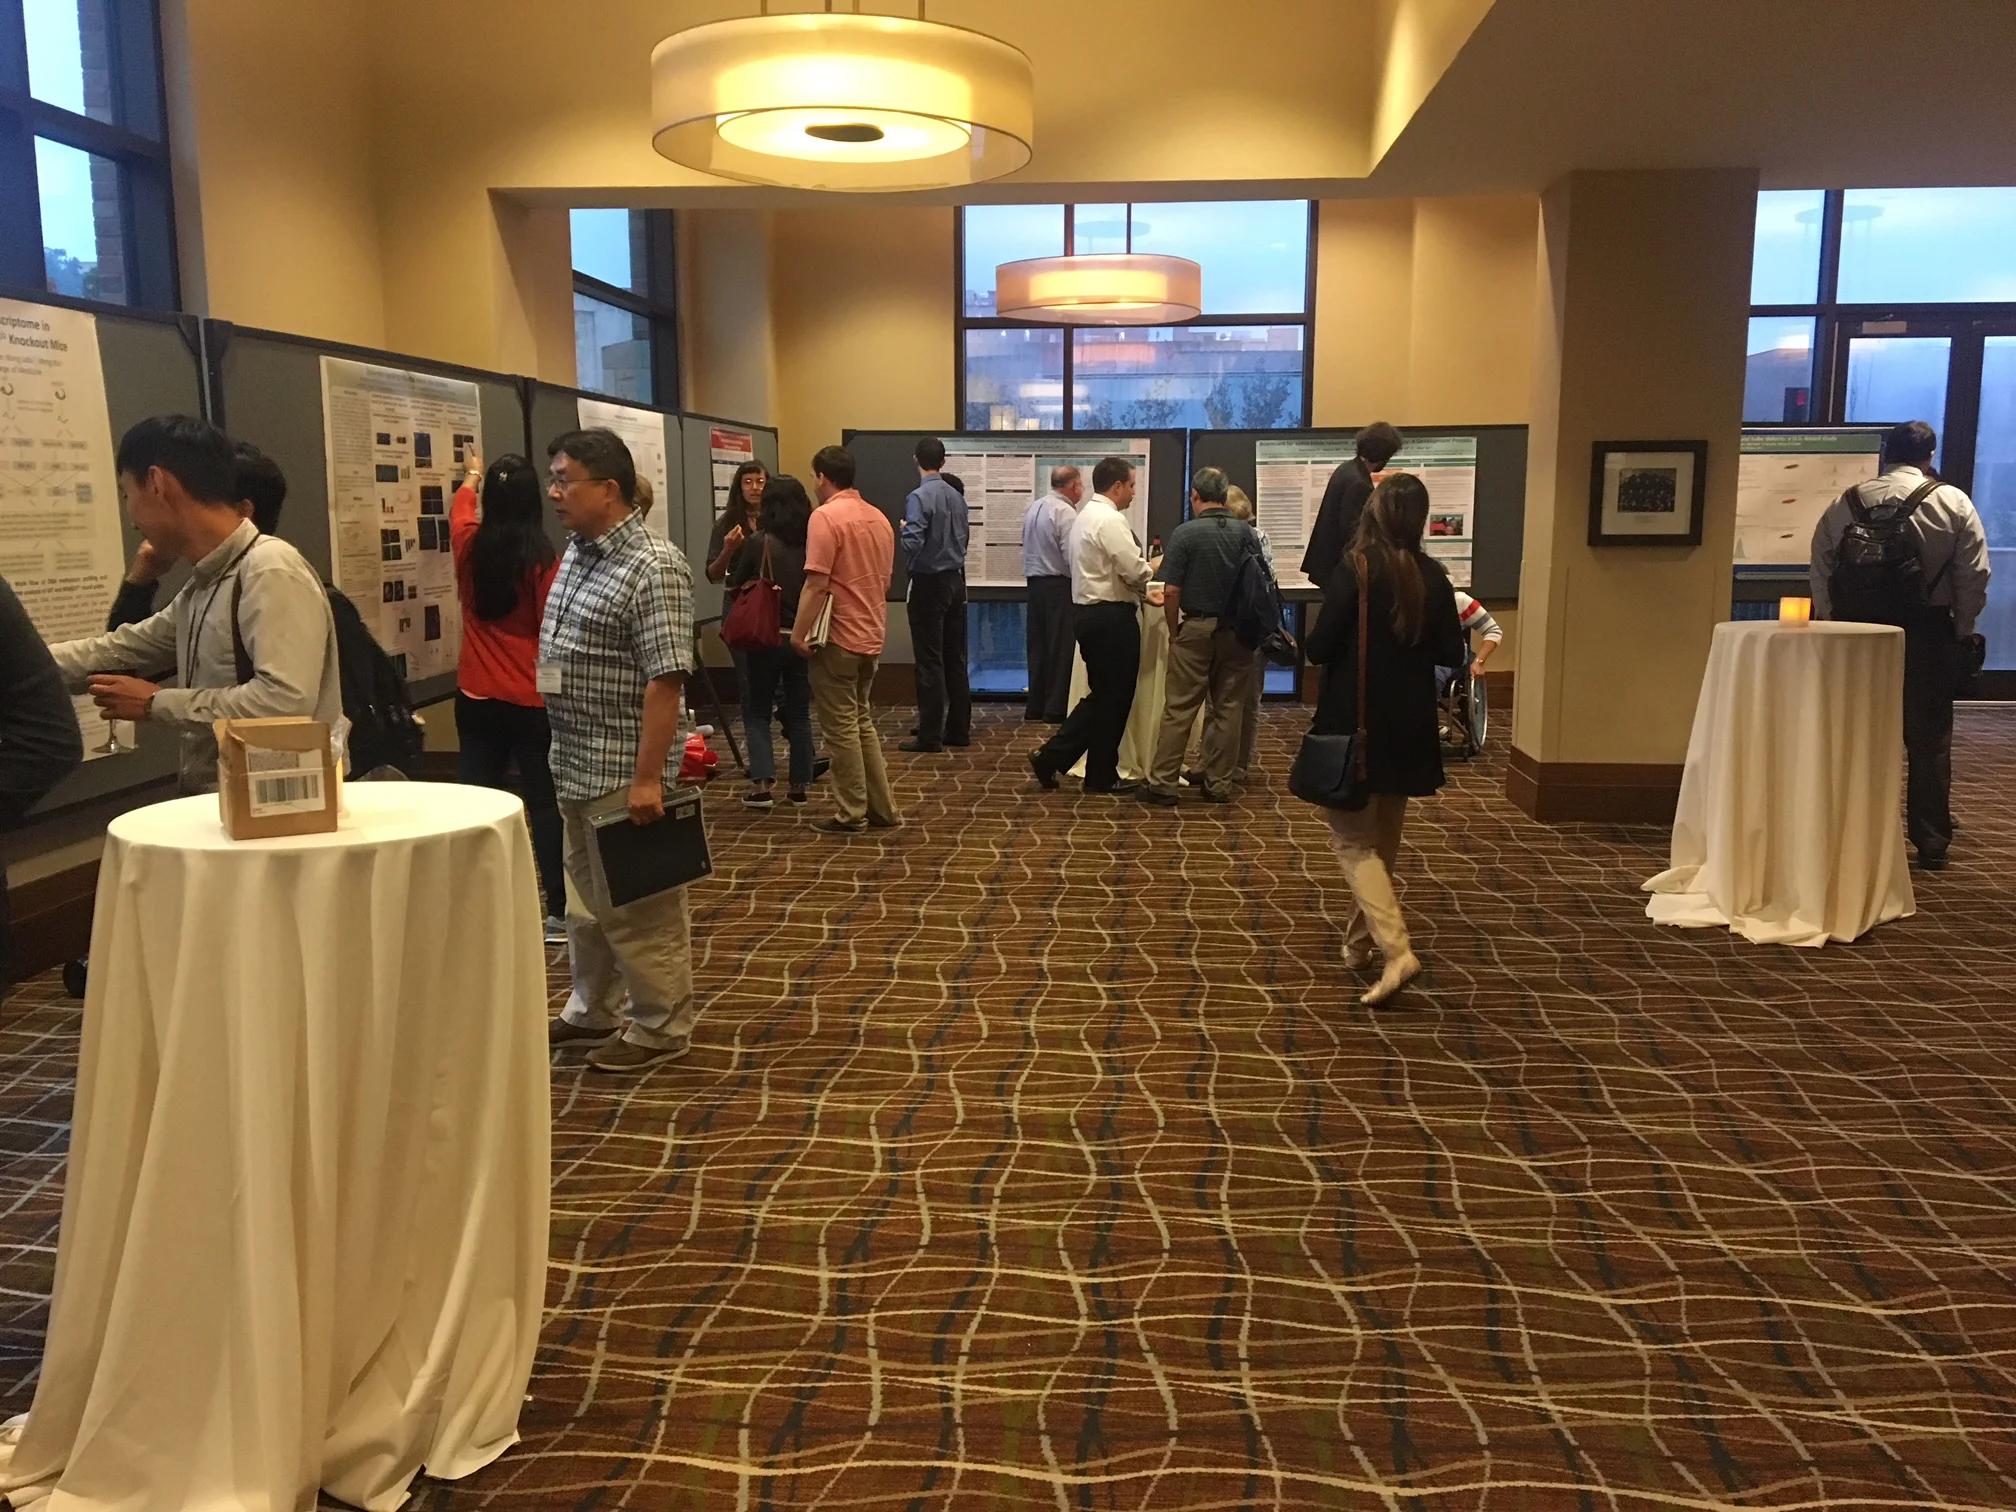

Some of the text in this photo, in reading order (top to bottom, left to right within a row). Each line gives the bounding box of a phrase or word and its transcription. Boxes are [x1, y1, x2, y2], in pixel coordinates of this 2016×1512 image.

[41, 320, 50, 331] in
[9, 333, 49, 349] Knockout
[50, 339, 68, 352] Mice
